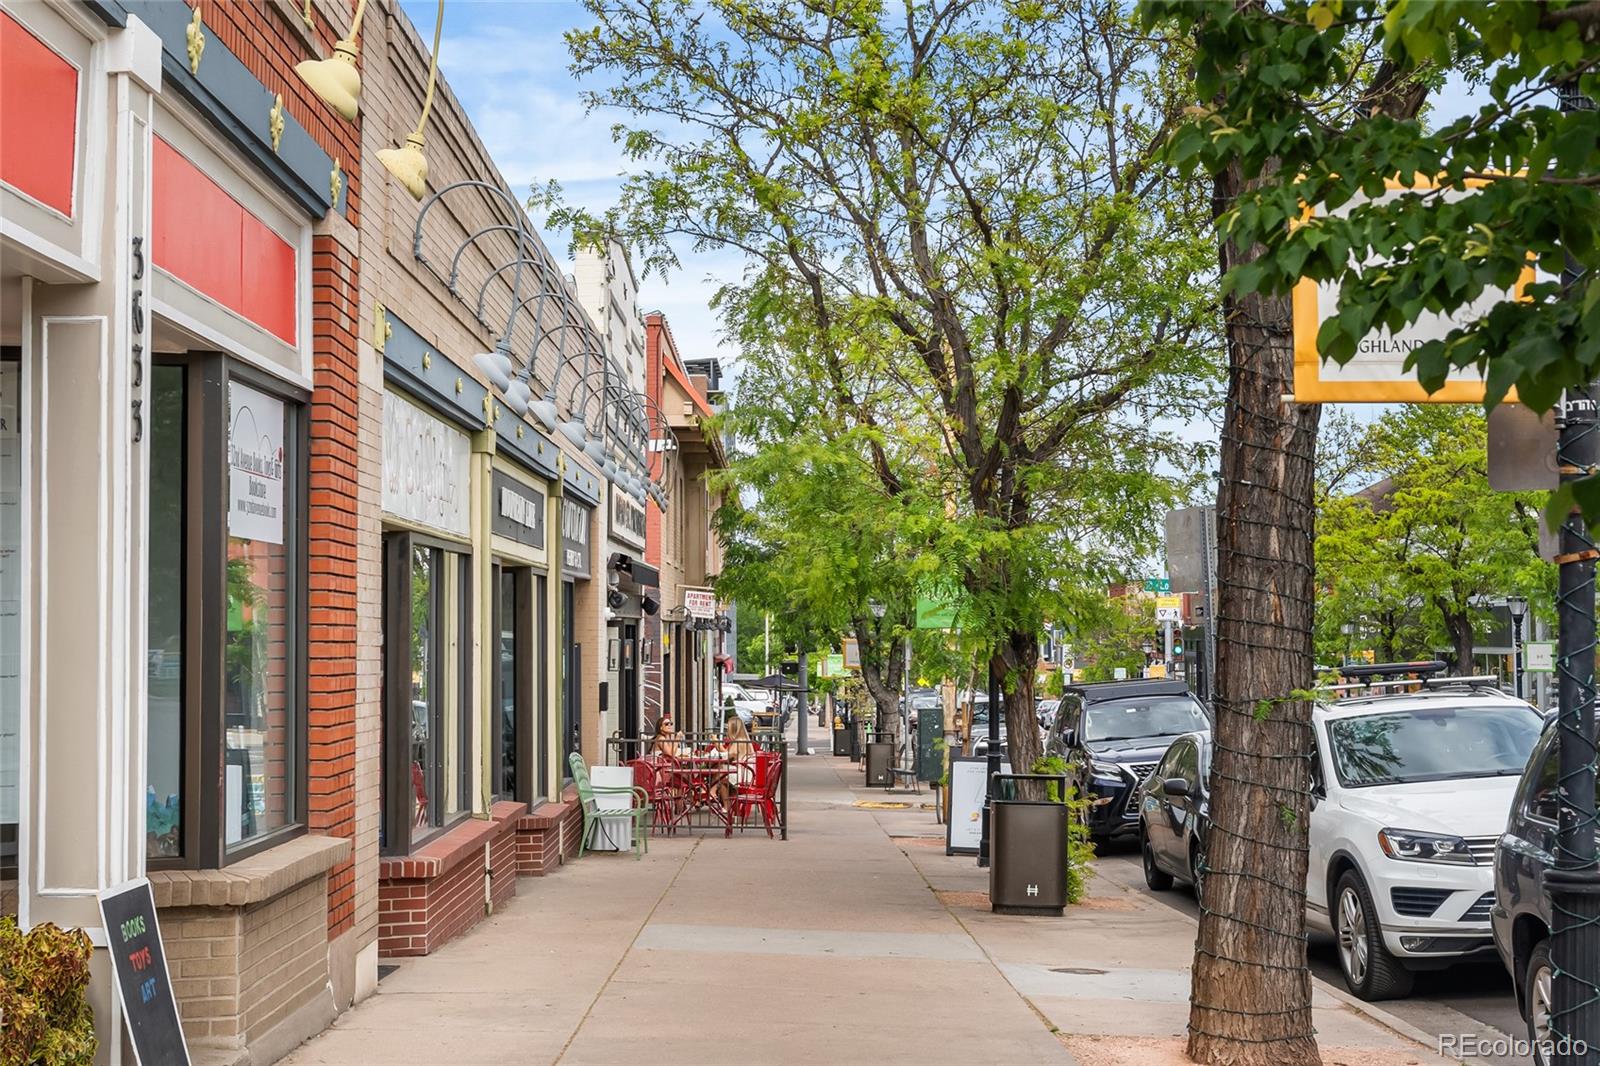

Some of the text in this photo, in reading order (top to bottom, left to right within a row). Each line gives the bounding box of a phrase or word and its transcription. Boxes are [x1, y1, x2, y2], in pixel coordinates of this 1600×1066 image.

[1359, 339, 1425, 353] GHLAND
[120, 915, 146, 943] BOOKS
[129, 946, 152, 973] TOYS
[141, 977, 157, 1004] ART
